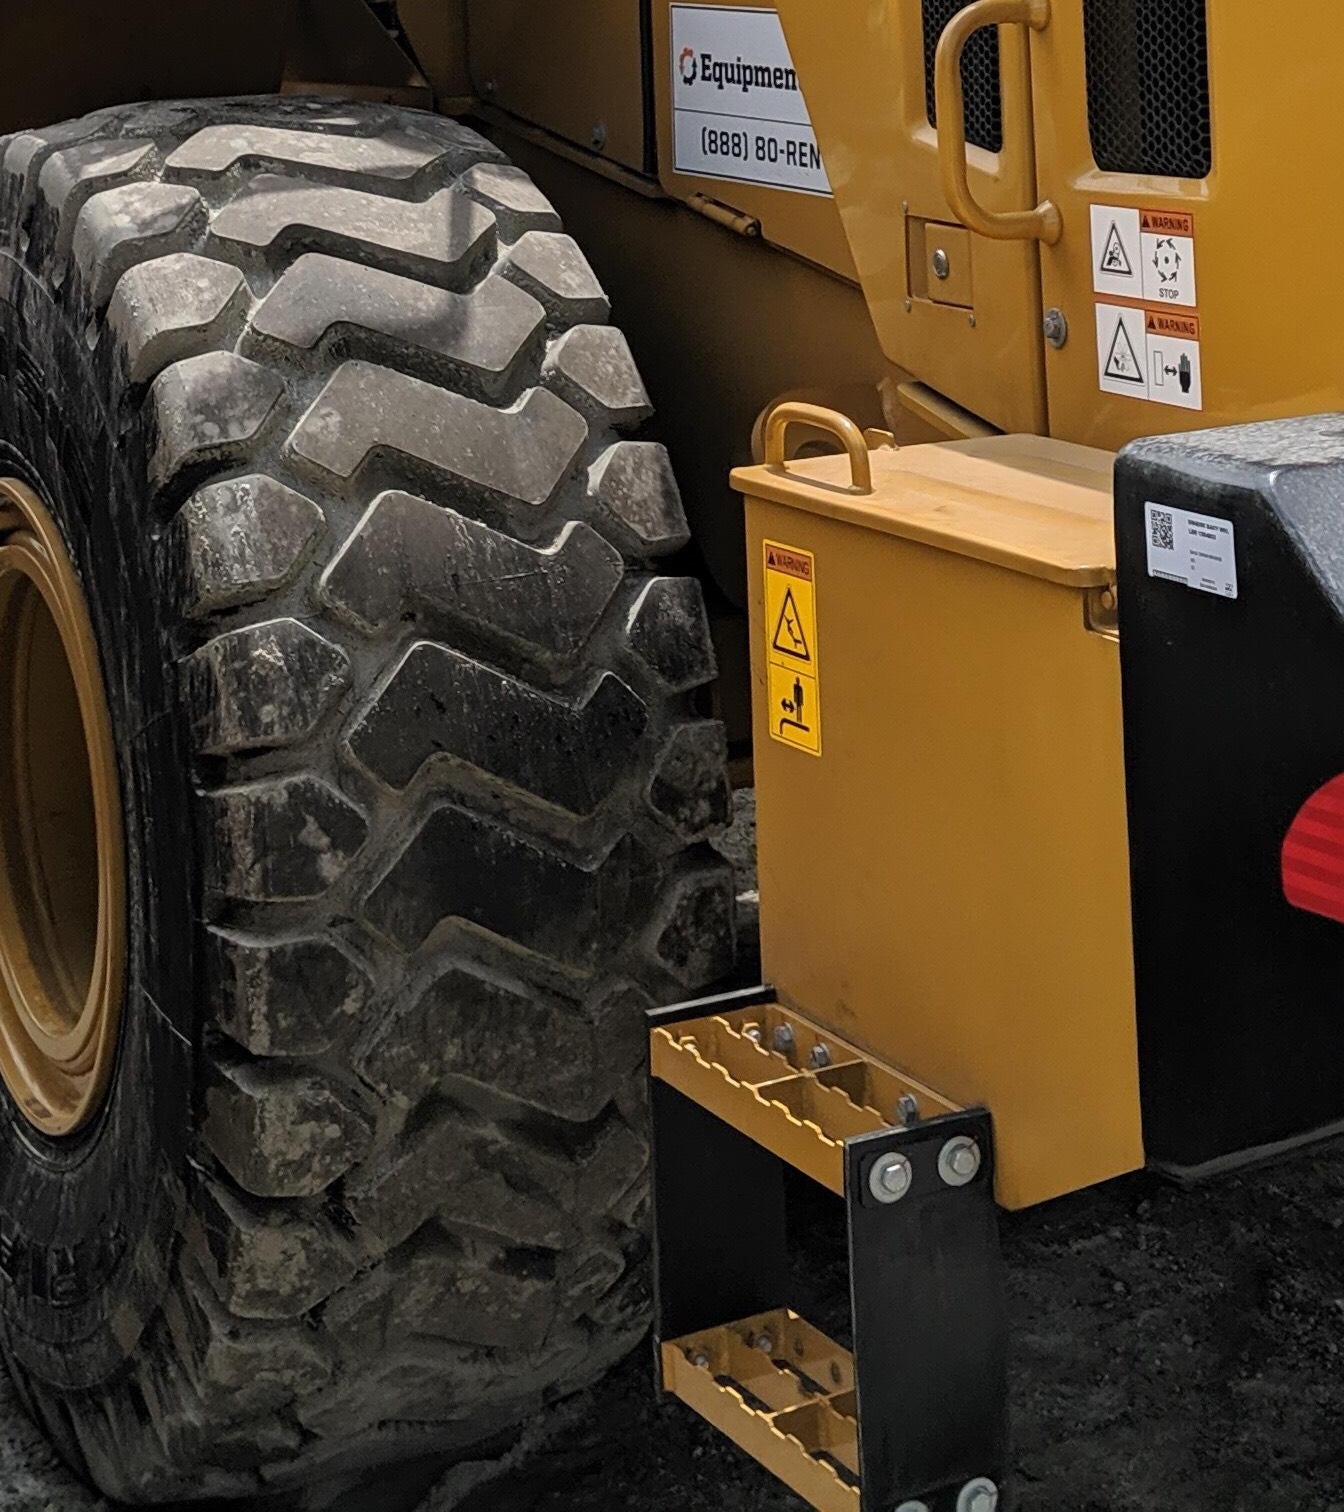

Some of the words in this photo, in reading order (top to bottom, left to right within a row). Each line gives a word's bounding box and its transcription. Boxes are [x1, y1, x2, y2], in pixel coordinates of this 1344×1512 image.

[700, 53, 798, 92] Equipmen
[701, 126, 749, 161] (888)
[755, 136, 821, 170] 80-REN
[1151, 215, 1189, 233] WARNING
[1158, 287, 1180, 300] STOP
[1158, 316, 1196, 335] WARNING
[776, 553, 810, 576] WARNING
